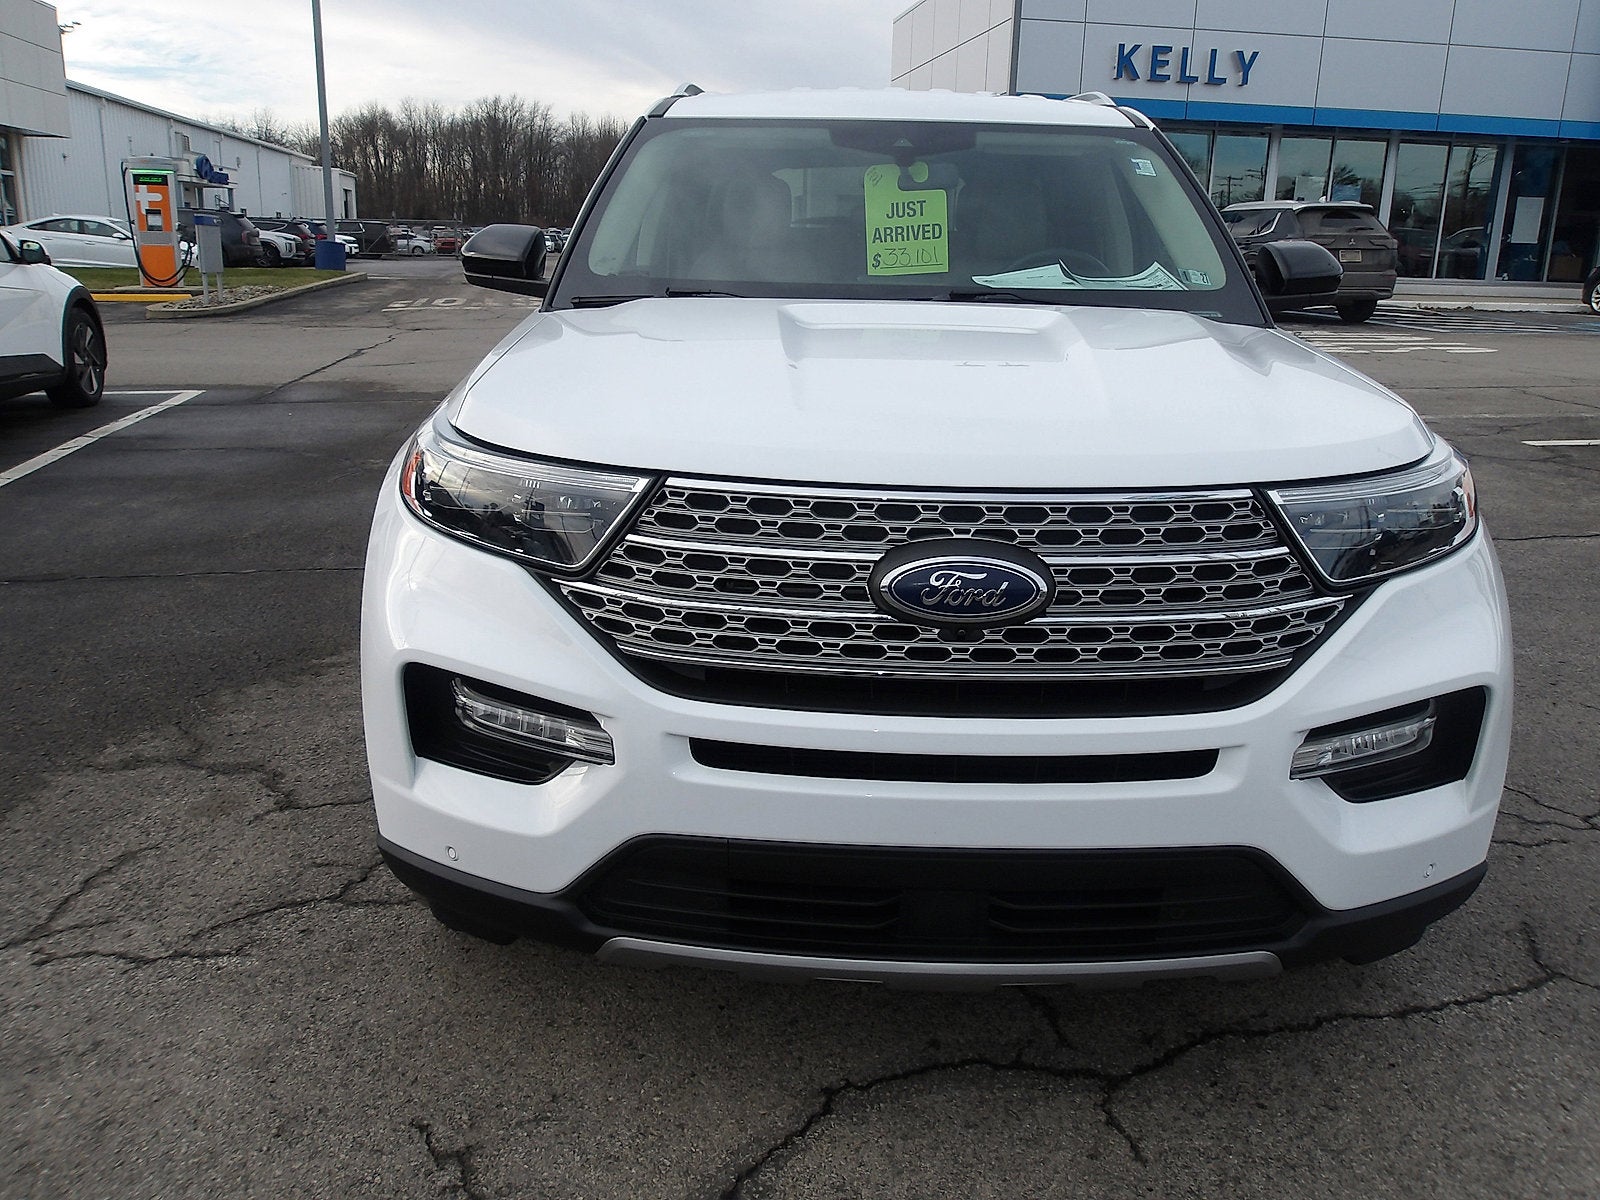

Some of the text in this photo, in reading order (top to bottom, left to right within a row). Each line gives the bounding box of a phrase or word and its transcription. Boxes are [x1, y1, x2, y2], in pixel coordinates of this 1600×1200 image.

[1113, 43, 1260, 86] KELLY
[886, 200, 926, 219] JUST
[872, 223, 943, 244] ARRIVED
[920, 570, 1008, 607] Ford
